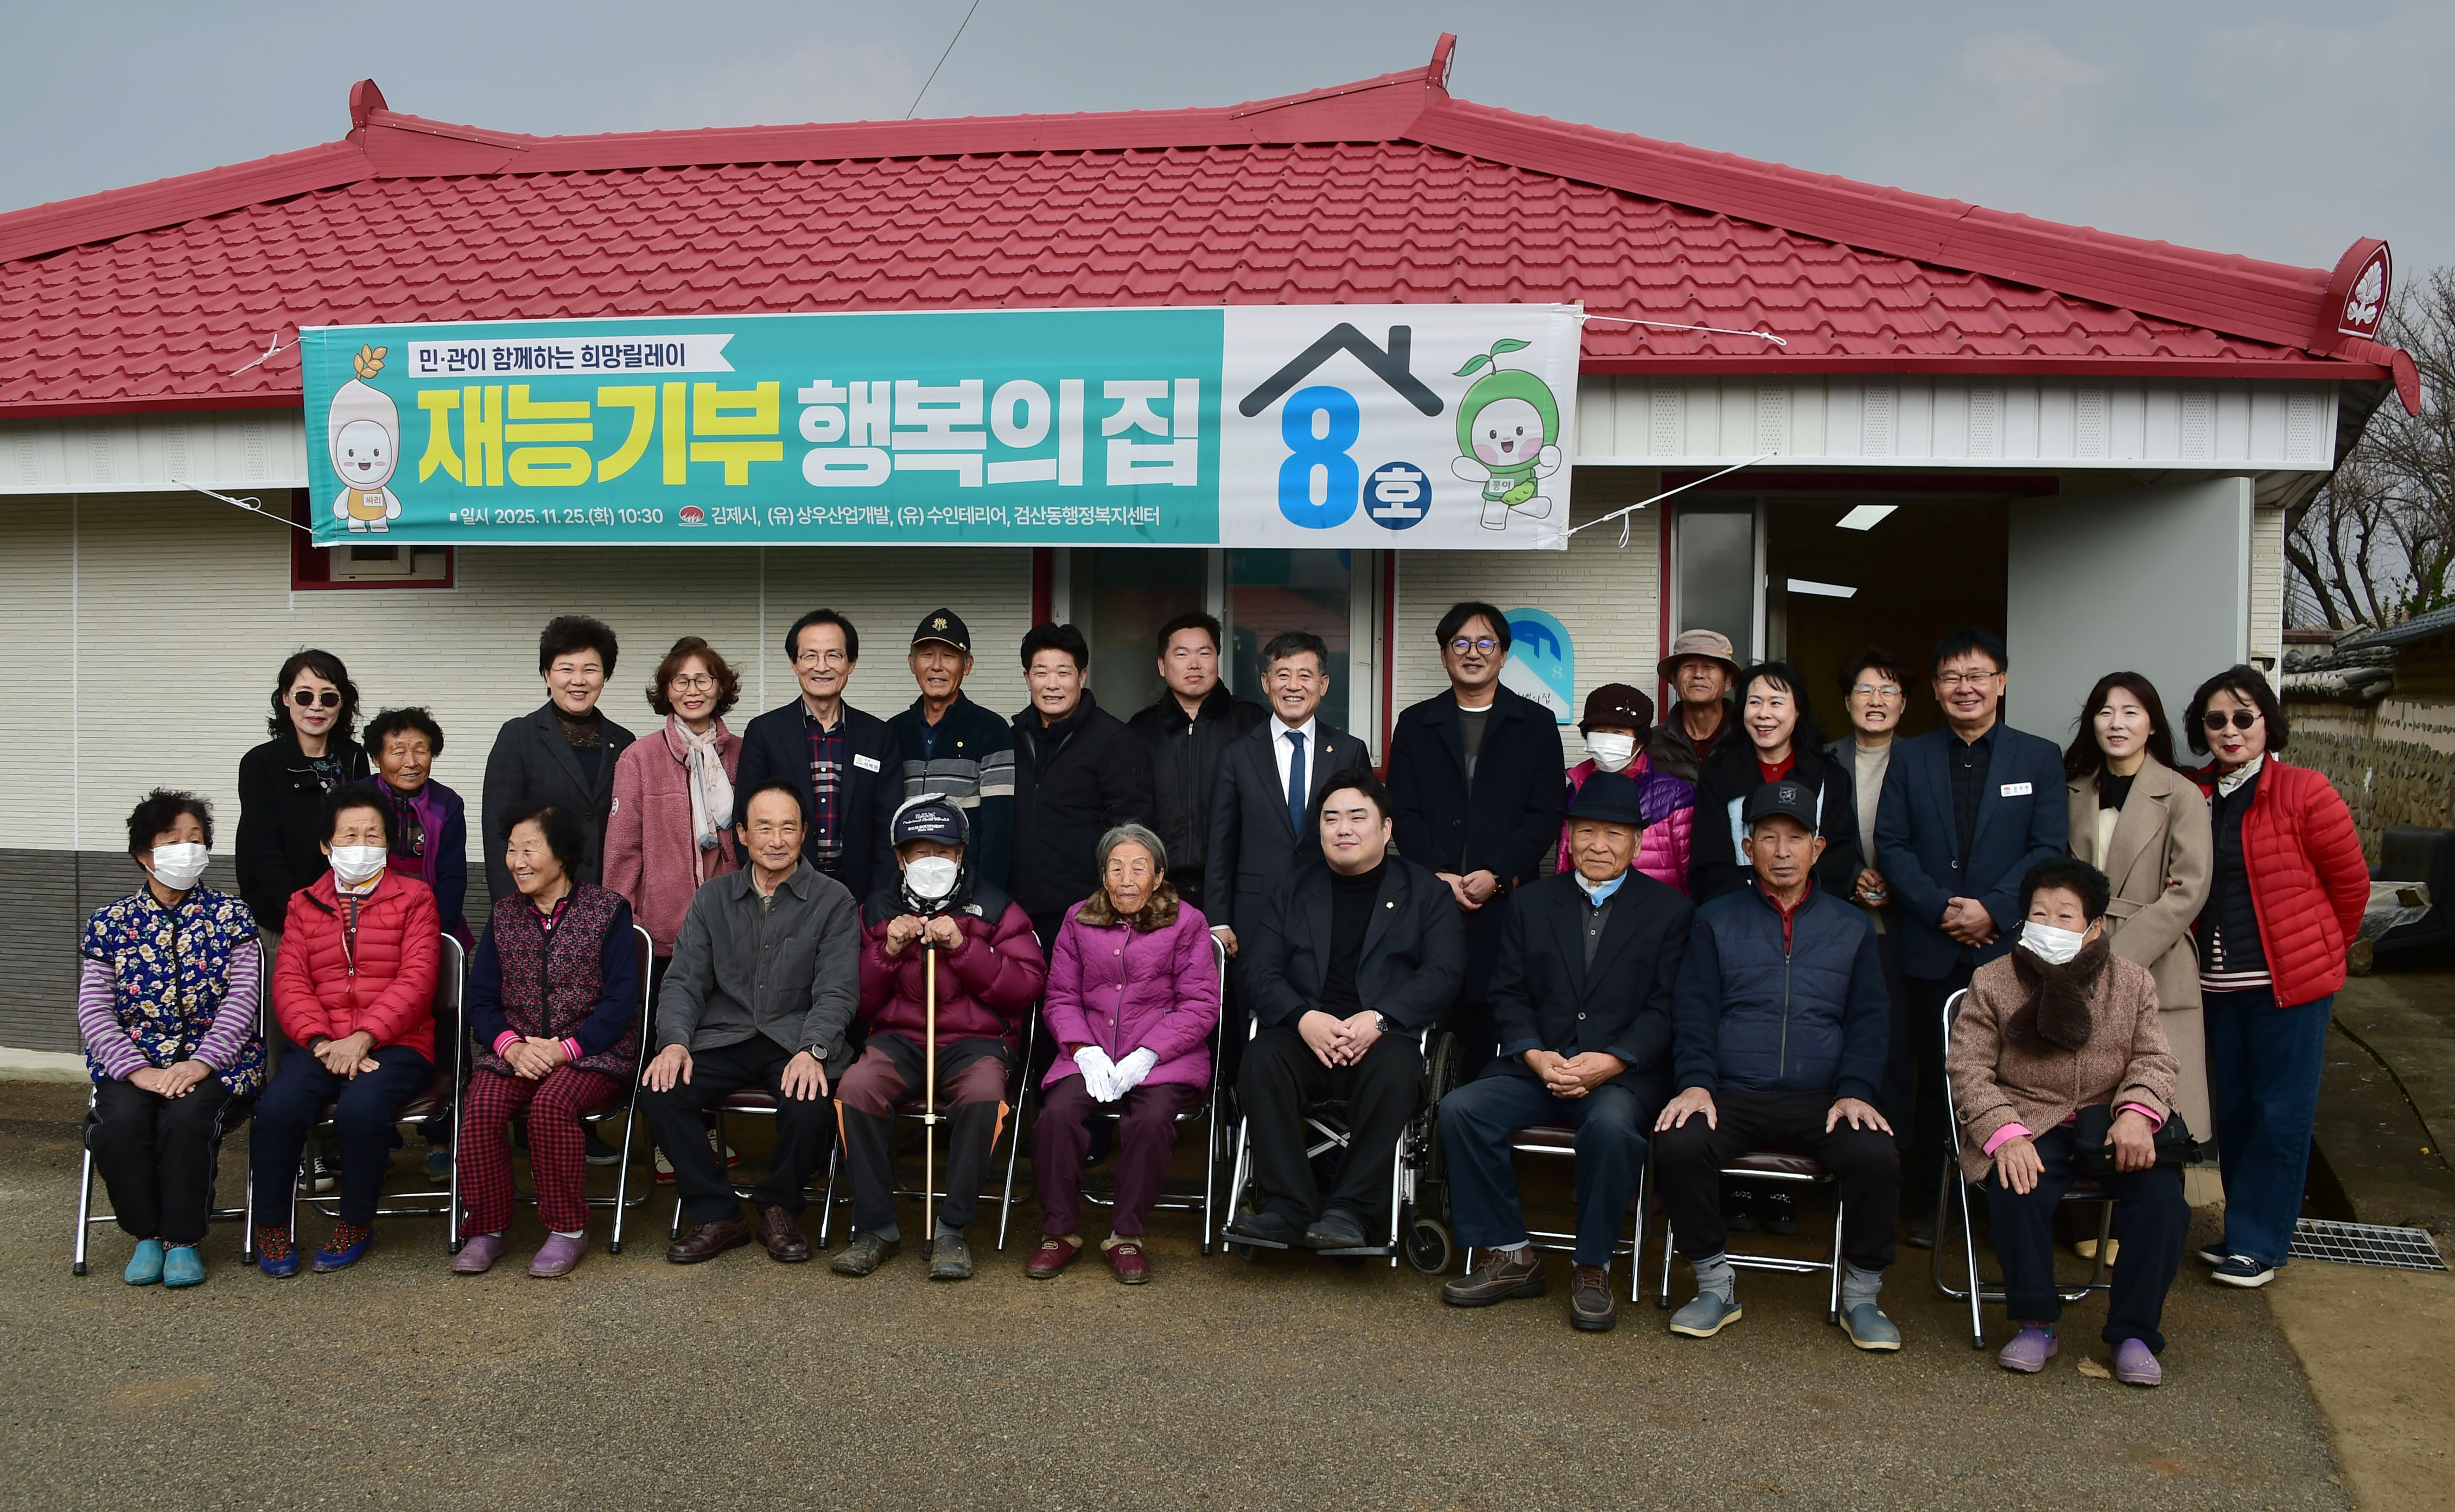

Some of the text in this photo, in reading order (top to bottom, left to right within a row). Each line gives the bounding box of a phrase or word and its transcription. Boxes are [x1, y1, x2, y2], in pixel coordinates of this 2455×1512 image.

[419, 343, 685, 372] 민·관이 함께하는 희망릴레이
[417, 378, 1200, 487] 재능기부 행복의 집
[1492, 480, 1511, 491] 콩이
[366, 496, 381, 505] 싸리
[460, 507, 489, 525] 일시
[618, 508, 664, 524] 10:30
[711, 506, 761, 527] 김제시,
[1014, 506, 1160, 526] 검산동행정복지센터
